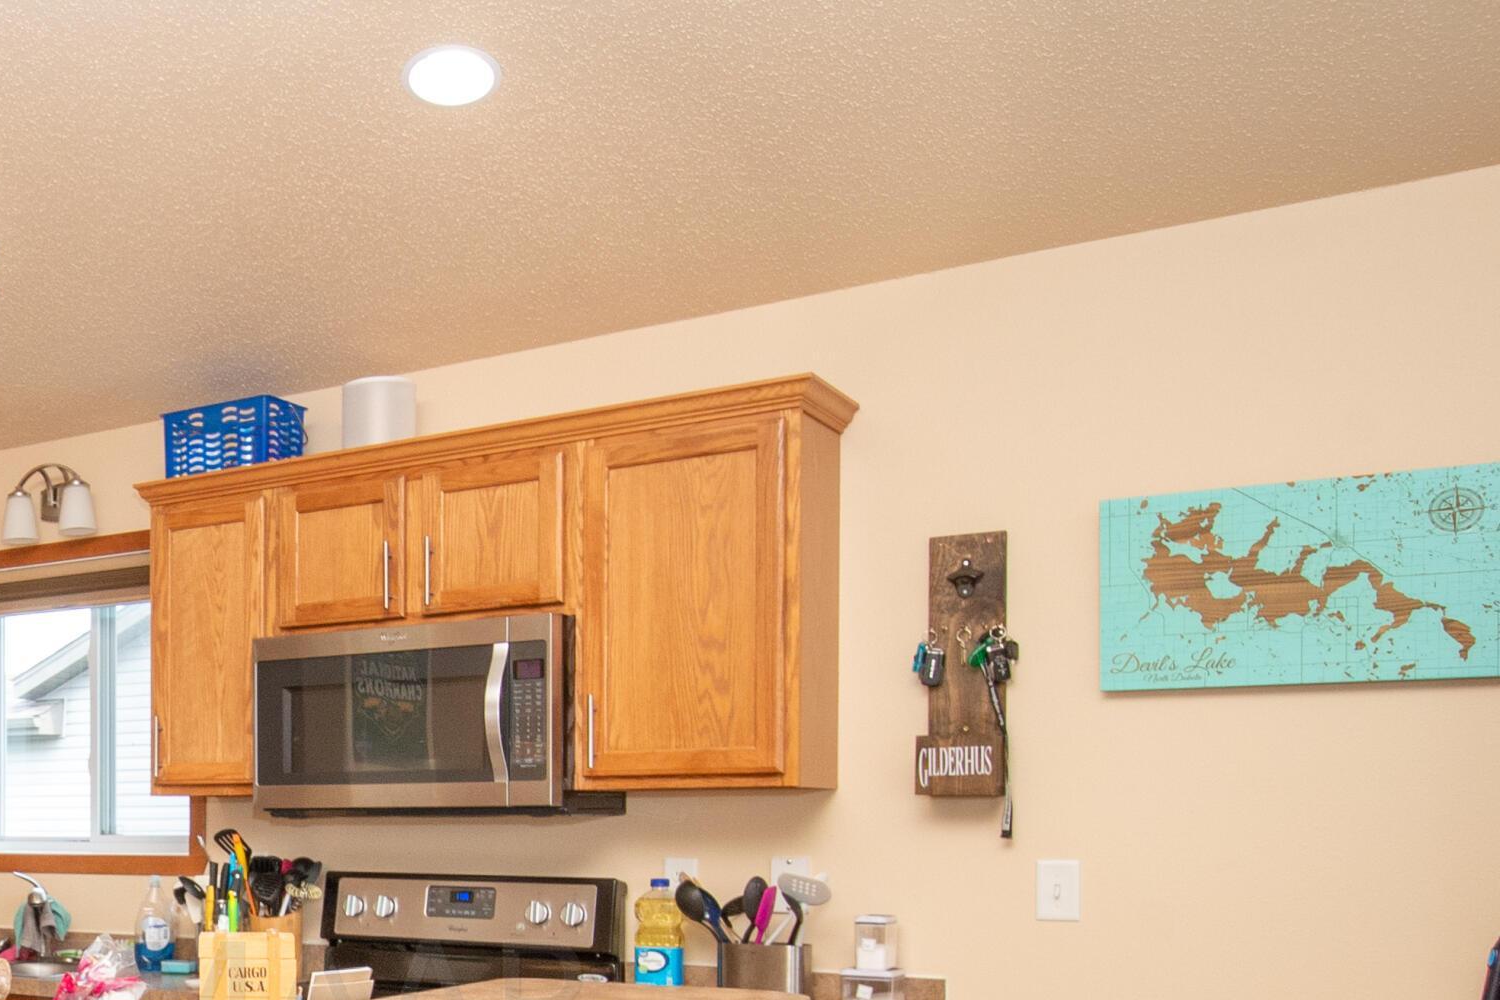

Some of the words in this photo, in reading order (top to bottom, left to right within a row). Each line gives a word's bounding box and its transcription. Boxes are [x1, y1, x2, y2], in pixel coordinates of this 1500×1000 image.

[1110, 653, 1178, 674] Devil's
[1184, 647, 1237, 676] Lake
[918, 745, 993, 788] GILDERHUS
[228, 967, 267, 979] CARGO
